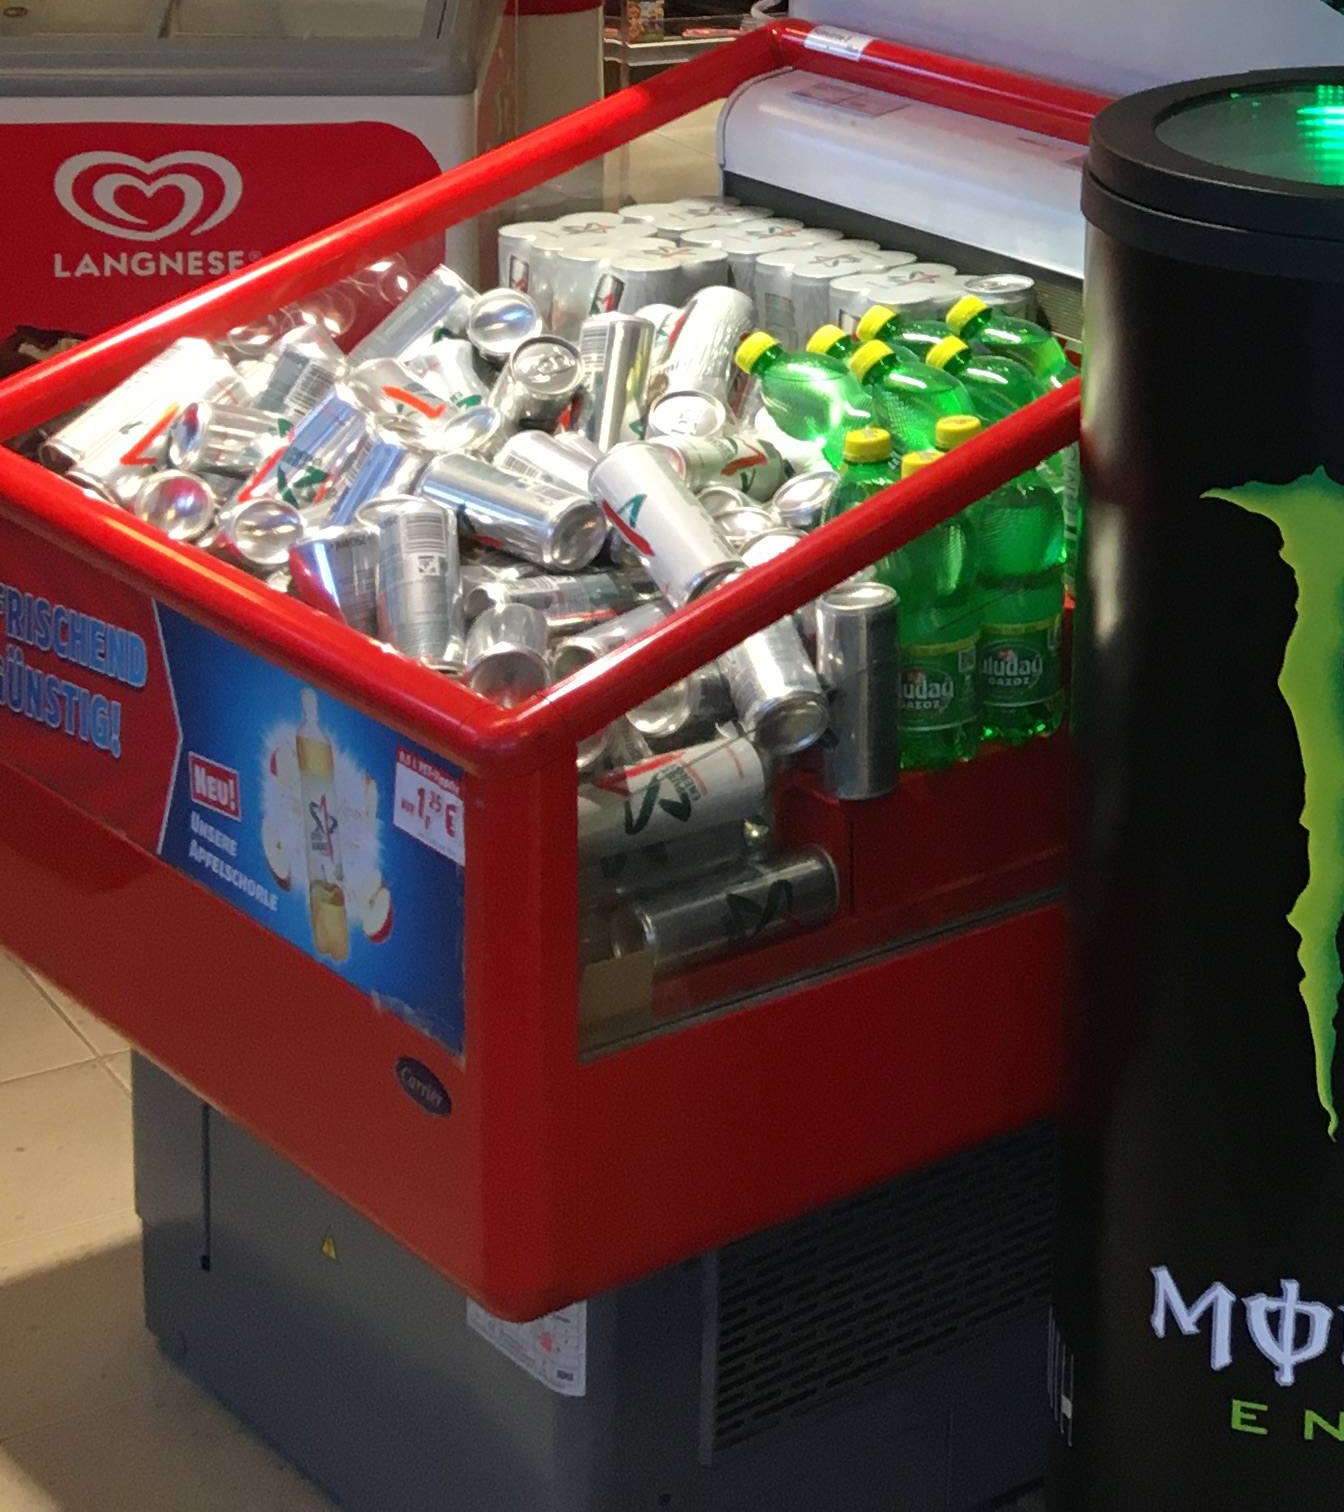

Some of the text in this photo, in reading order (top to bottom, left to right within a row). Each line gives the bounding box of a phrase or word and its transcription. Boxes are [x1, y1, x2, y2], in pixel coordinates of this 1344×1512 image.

[54, 251, 244, 278] LANGNESE
[191, 810, 237, 858] UNSERE
[189, 839, 278, 912] APFELSCHORLE
[403, 1068, 444, 1107] Carrier
